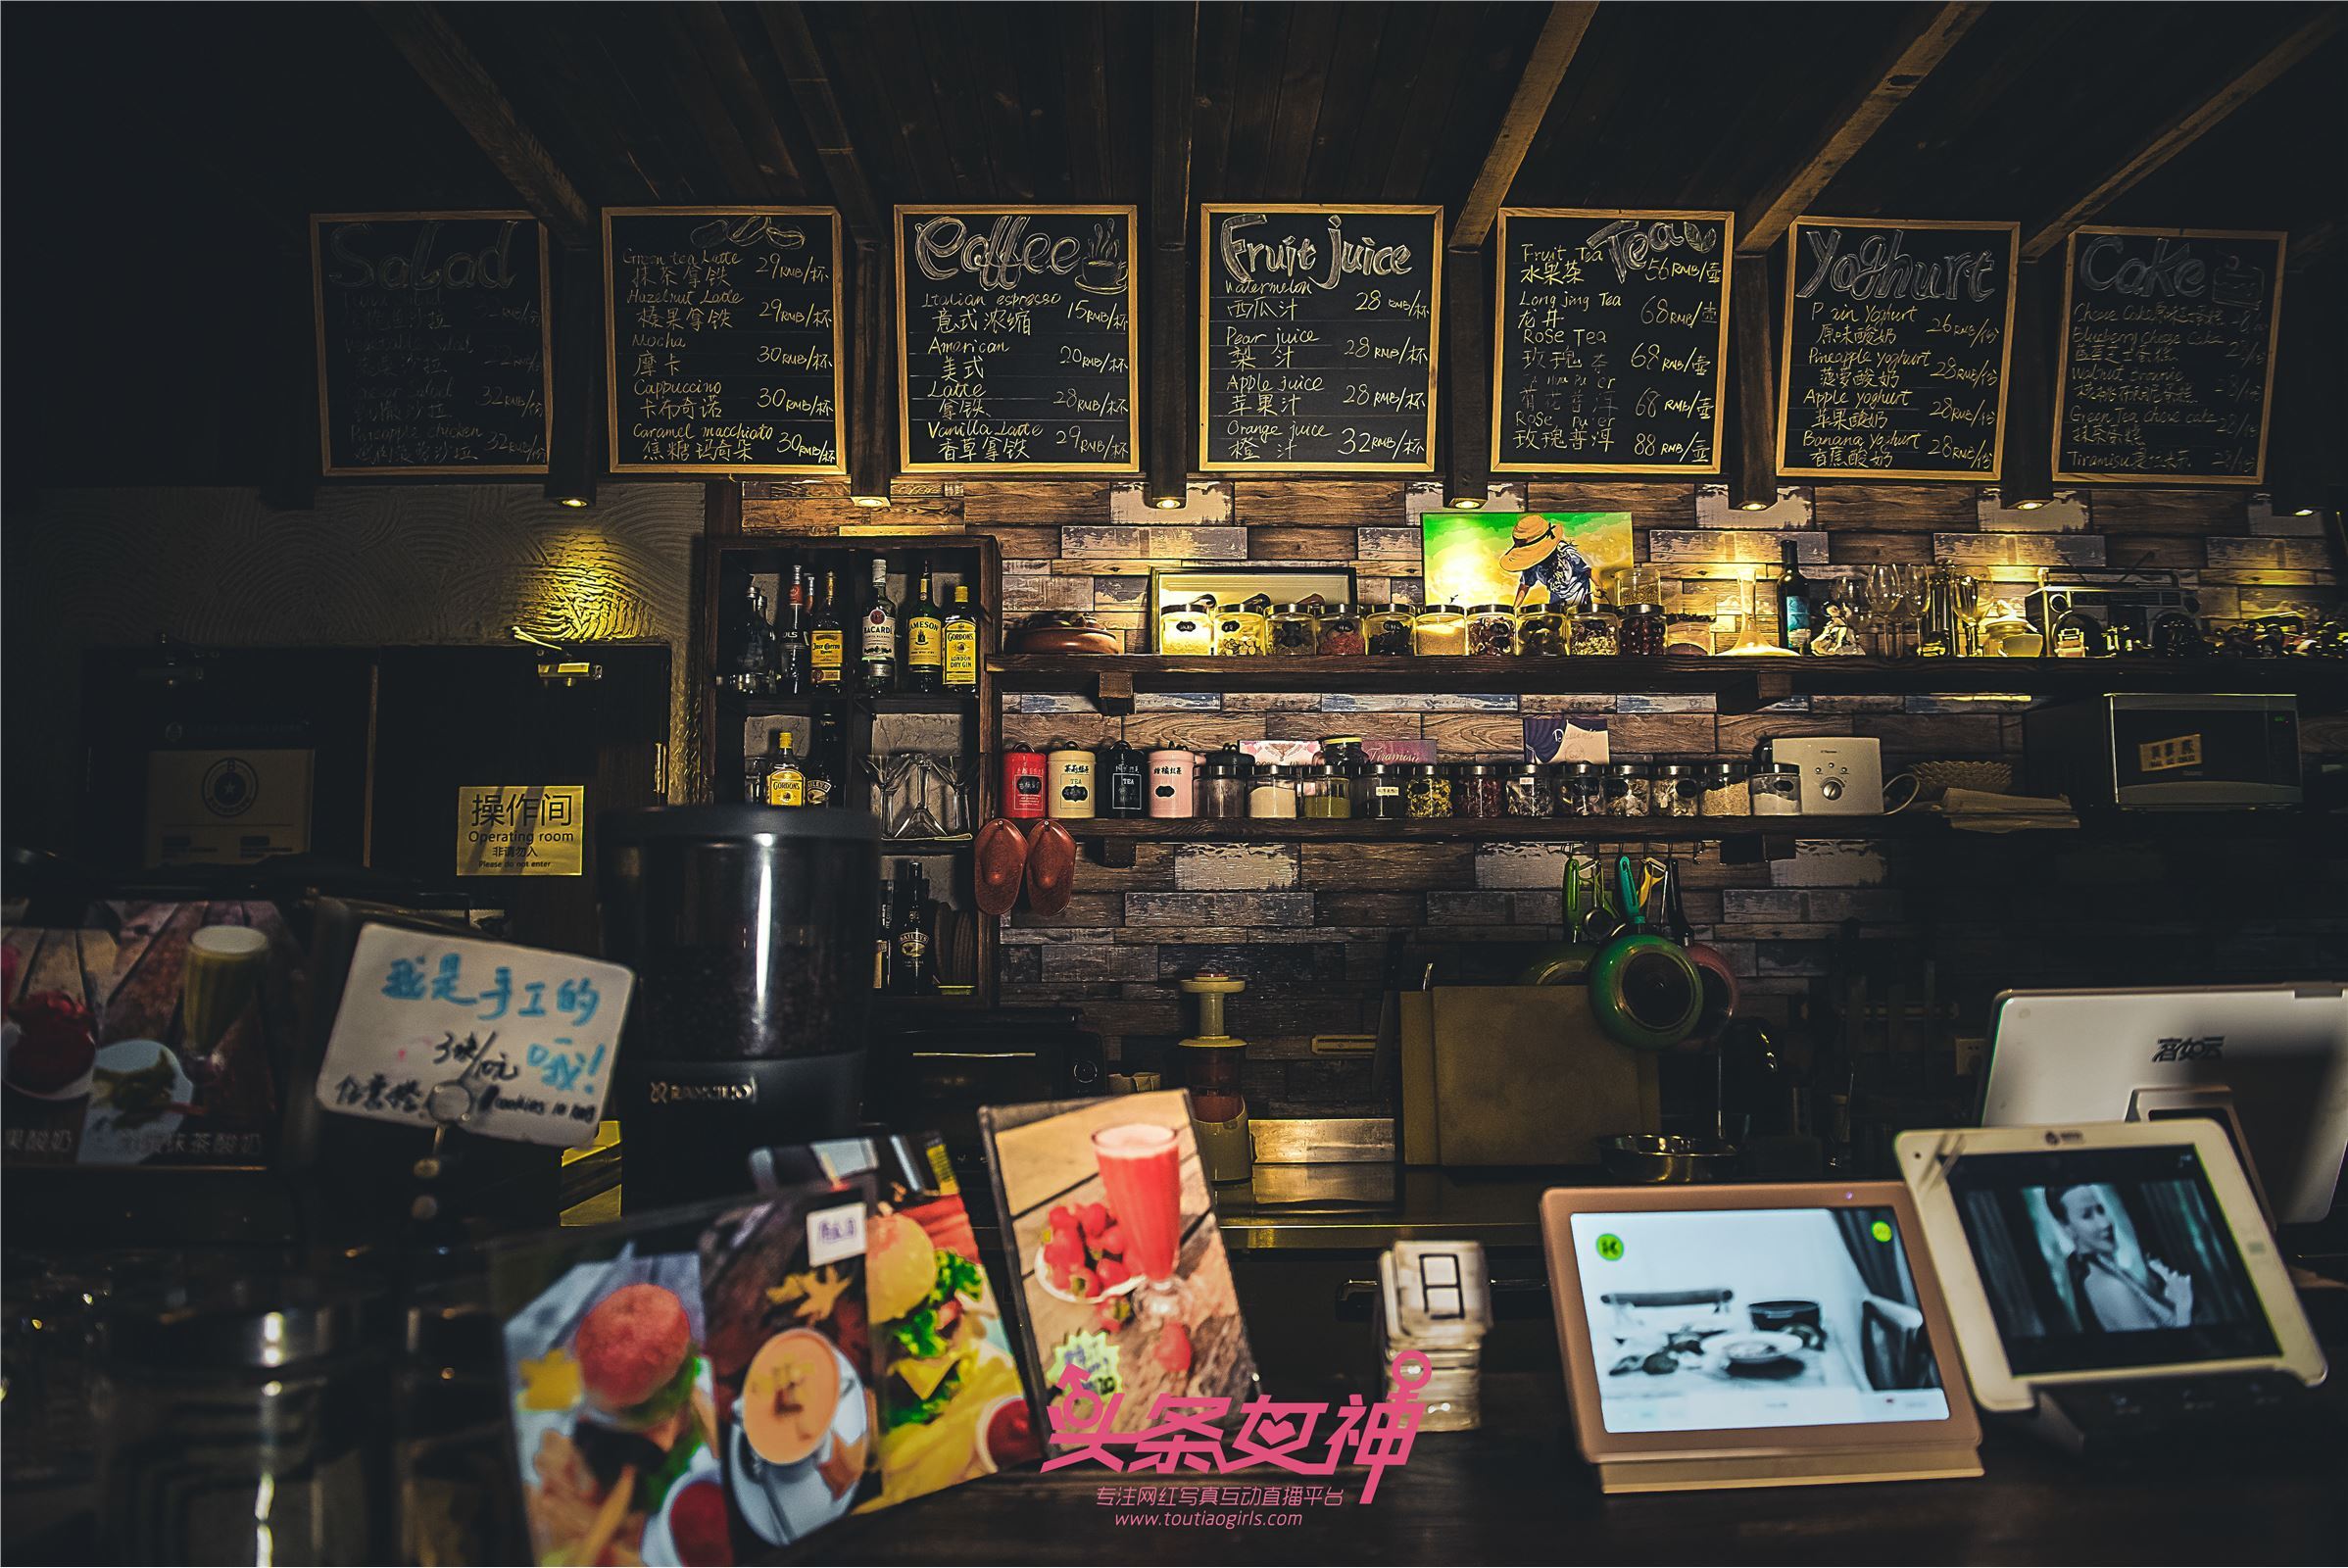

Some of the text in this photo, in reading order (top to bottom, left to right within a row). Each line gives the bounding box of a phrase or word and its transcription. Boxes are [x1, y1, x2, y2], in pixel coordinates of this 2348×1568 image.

[328, 220, 518, 291] Salad
[915, 216, 1081, 292] Coffee
[1221, 214, 1317, 283] Fruit
[1521, 243, 1604, 262] Fruit Tea
[1586, 220, 1685, 284] Tea
[1520, 260, 1585, 285] 水果茶
[1795, 228, 1995, 302] Yoghurt
[2080, 236, 2206, 297] Cake
[922, 292, 1061, 308] Italian espresso
[1227, 297, 1297, 320] 西瓜汁
[1598, 291, 1622, 307] Tea
[932, 308, 1031, 335] 意式浓缩
[927, 336, 1010, 356] American
[1227, 326, 1321, 354] Pear juice
[1573, 328, 1607, 347] Tea
[941, 356, 984, 382] 美式
[1809, 347, 1872, 370] Pineapple
[633, 380, 722, 400] Cappuccino
[1226, 374, 1325, 394] Apple juice
[1228, 393, 1301, 416] 苹果汁
[1803, 389, 1848, 408] Apple
[633, 423, 695, 440] Caramel
[1227, 419, 1333, 443] Orange juice
[1803, 430, 1865, 448] Banana
[938, 436, 1030, 462] 香草拿铁
[1228, 437, 1297, 461] 橙汁
[470, 793, 573, 827] 操作间
[468, 830, 574, 846] Operating room
[492, 846, 538, 858] 非请勿入
